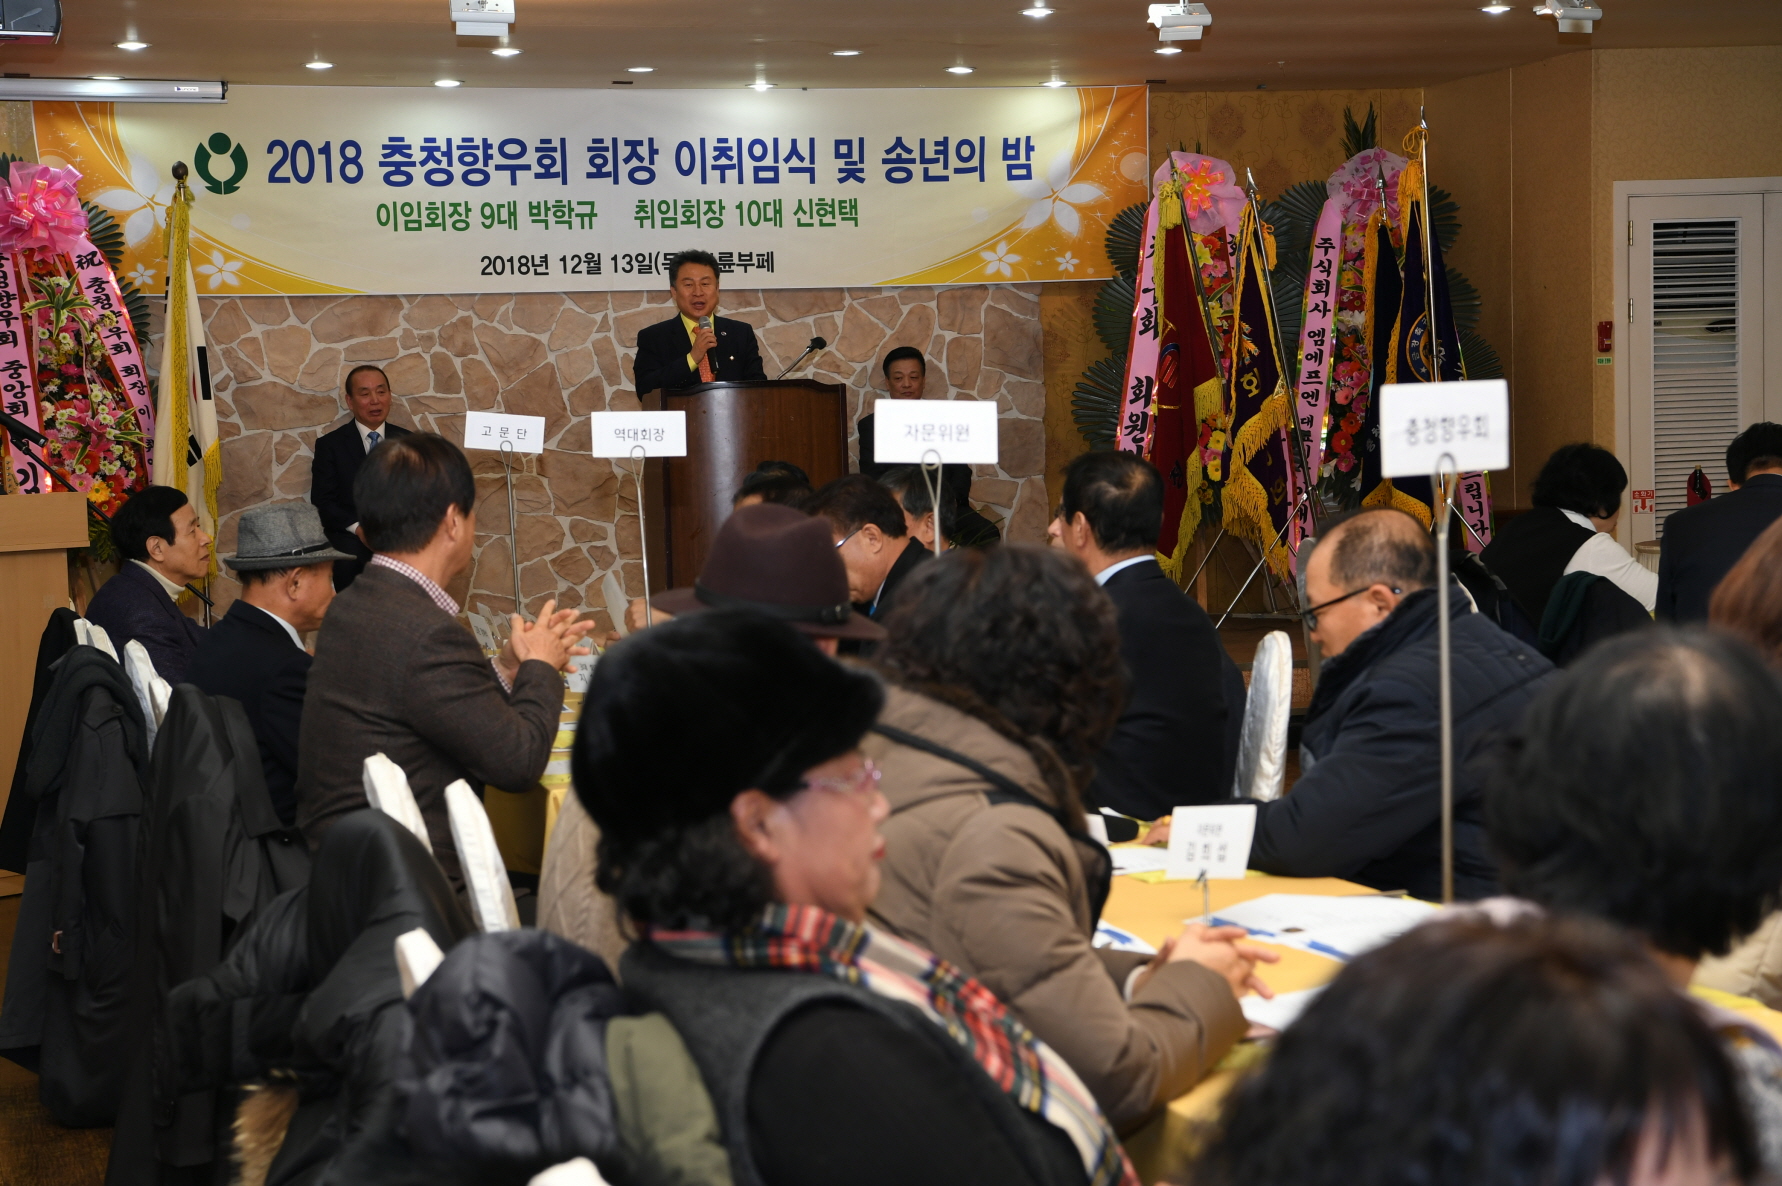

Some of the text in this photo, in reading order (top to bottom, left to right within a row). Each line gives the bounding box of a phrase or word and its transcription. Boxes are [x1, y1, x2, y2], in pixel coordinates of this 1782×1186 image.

[267, 135, 1035, 188] 2018 충청향우회 회장 이취임식 및 송년의 밤
[376, 197, 859, 232] 이임회장 9대 박학규 취임회장 10대 신현택
[74, 250, 104, 270] 祝
[480, 253, 550, 276] 2018년
[559, 252, 602, 276] 12월
[710, 250, 775, 275] 륜부페
[1308, 237, 1336, 319] 주식회사
[1301, 327, 1326, 407] 엠에프엔
[614, 427, 665, 442] 역대회장
[903, 423, 970, 442] 자문위원
